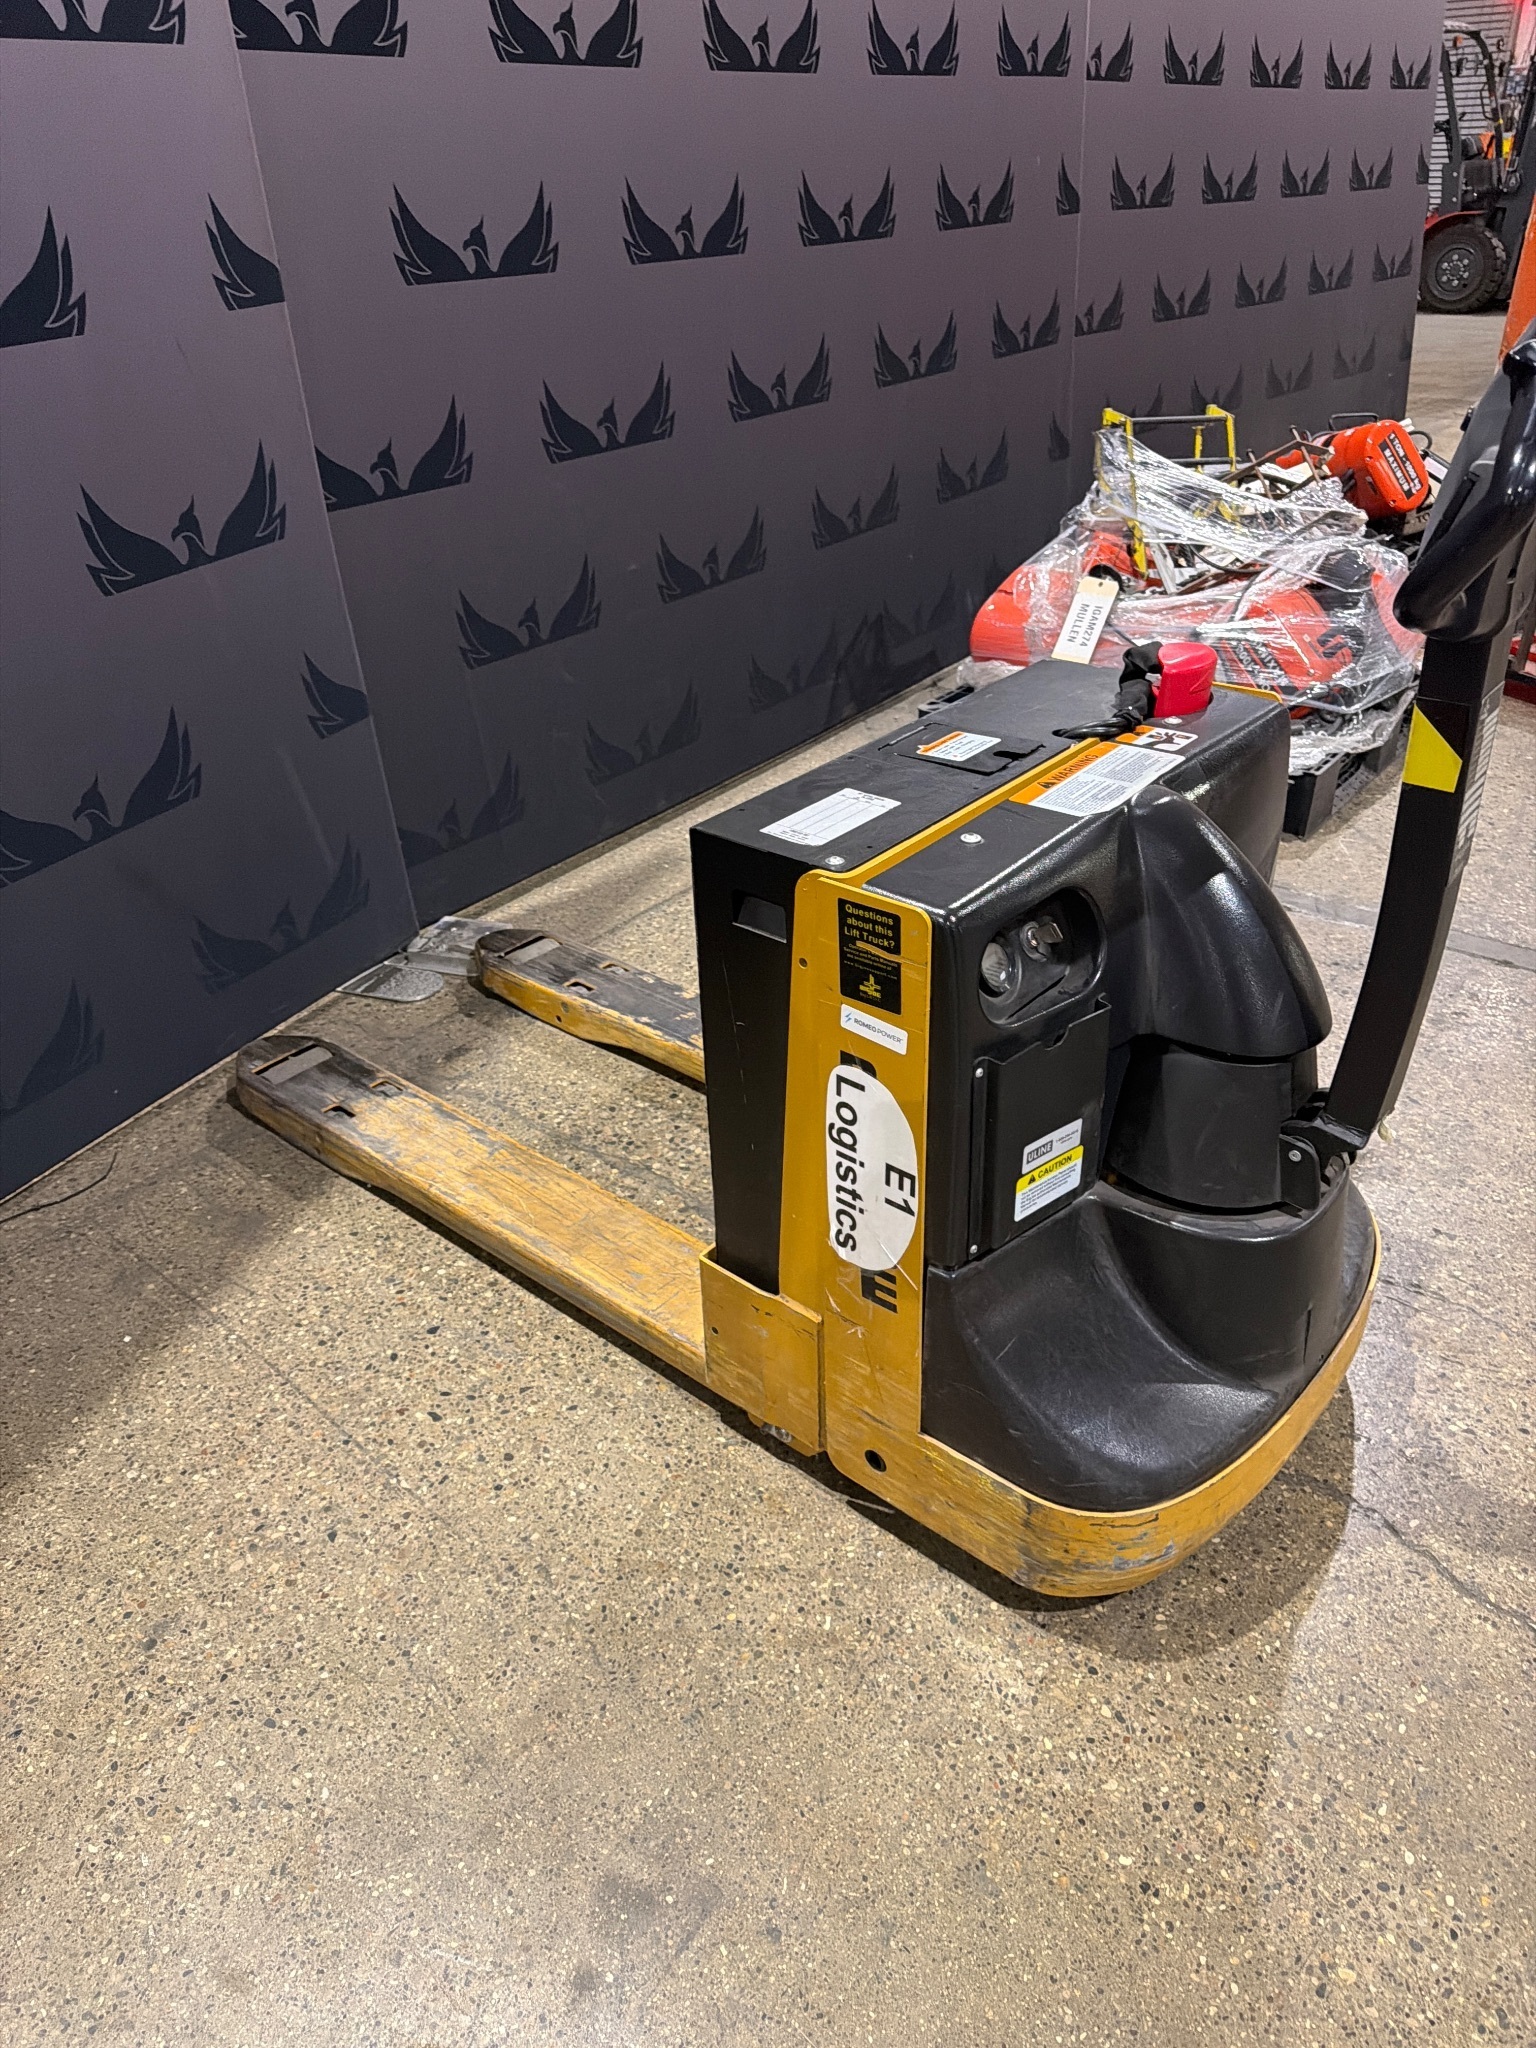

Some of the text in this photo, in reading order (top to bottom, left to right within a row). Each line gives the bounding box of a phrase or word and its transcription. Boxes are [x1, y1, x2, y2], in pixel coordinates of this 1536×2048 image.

[1392, 438, 1405, 458] TON
[1383, 447, 1410, 492] MAXIMUM
[1066, 603, 1090, 643] MULLEN
[1051, 754, 1100, 782] WARNING
[845, 903, 894, 925] Questions
[846, 916, 893, 937] about this
[844, 926, 895, 949] Lift Truck?
[853, 1017, 902, 1044] ROMEO POWER
[827, 1073, 866, 1253] Logistics
[1028, 1141, 1052, 1162] ULINE
[1037, 1154, 1073, 1179] CAUTION
[884, 1162, 916, 1219] E1
